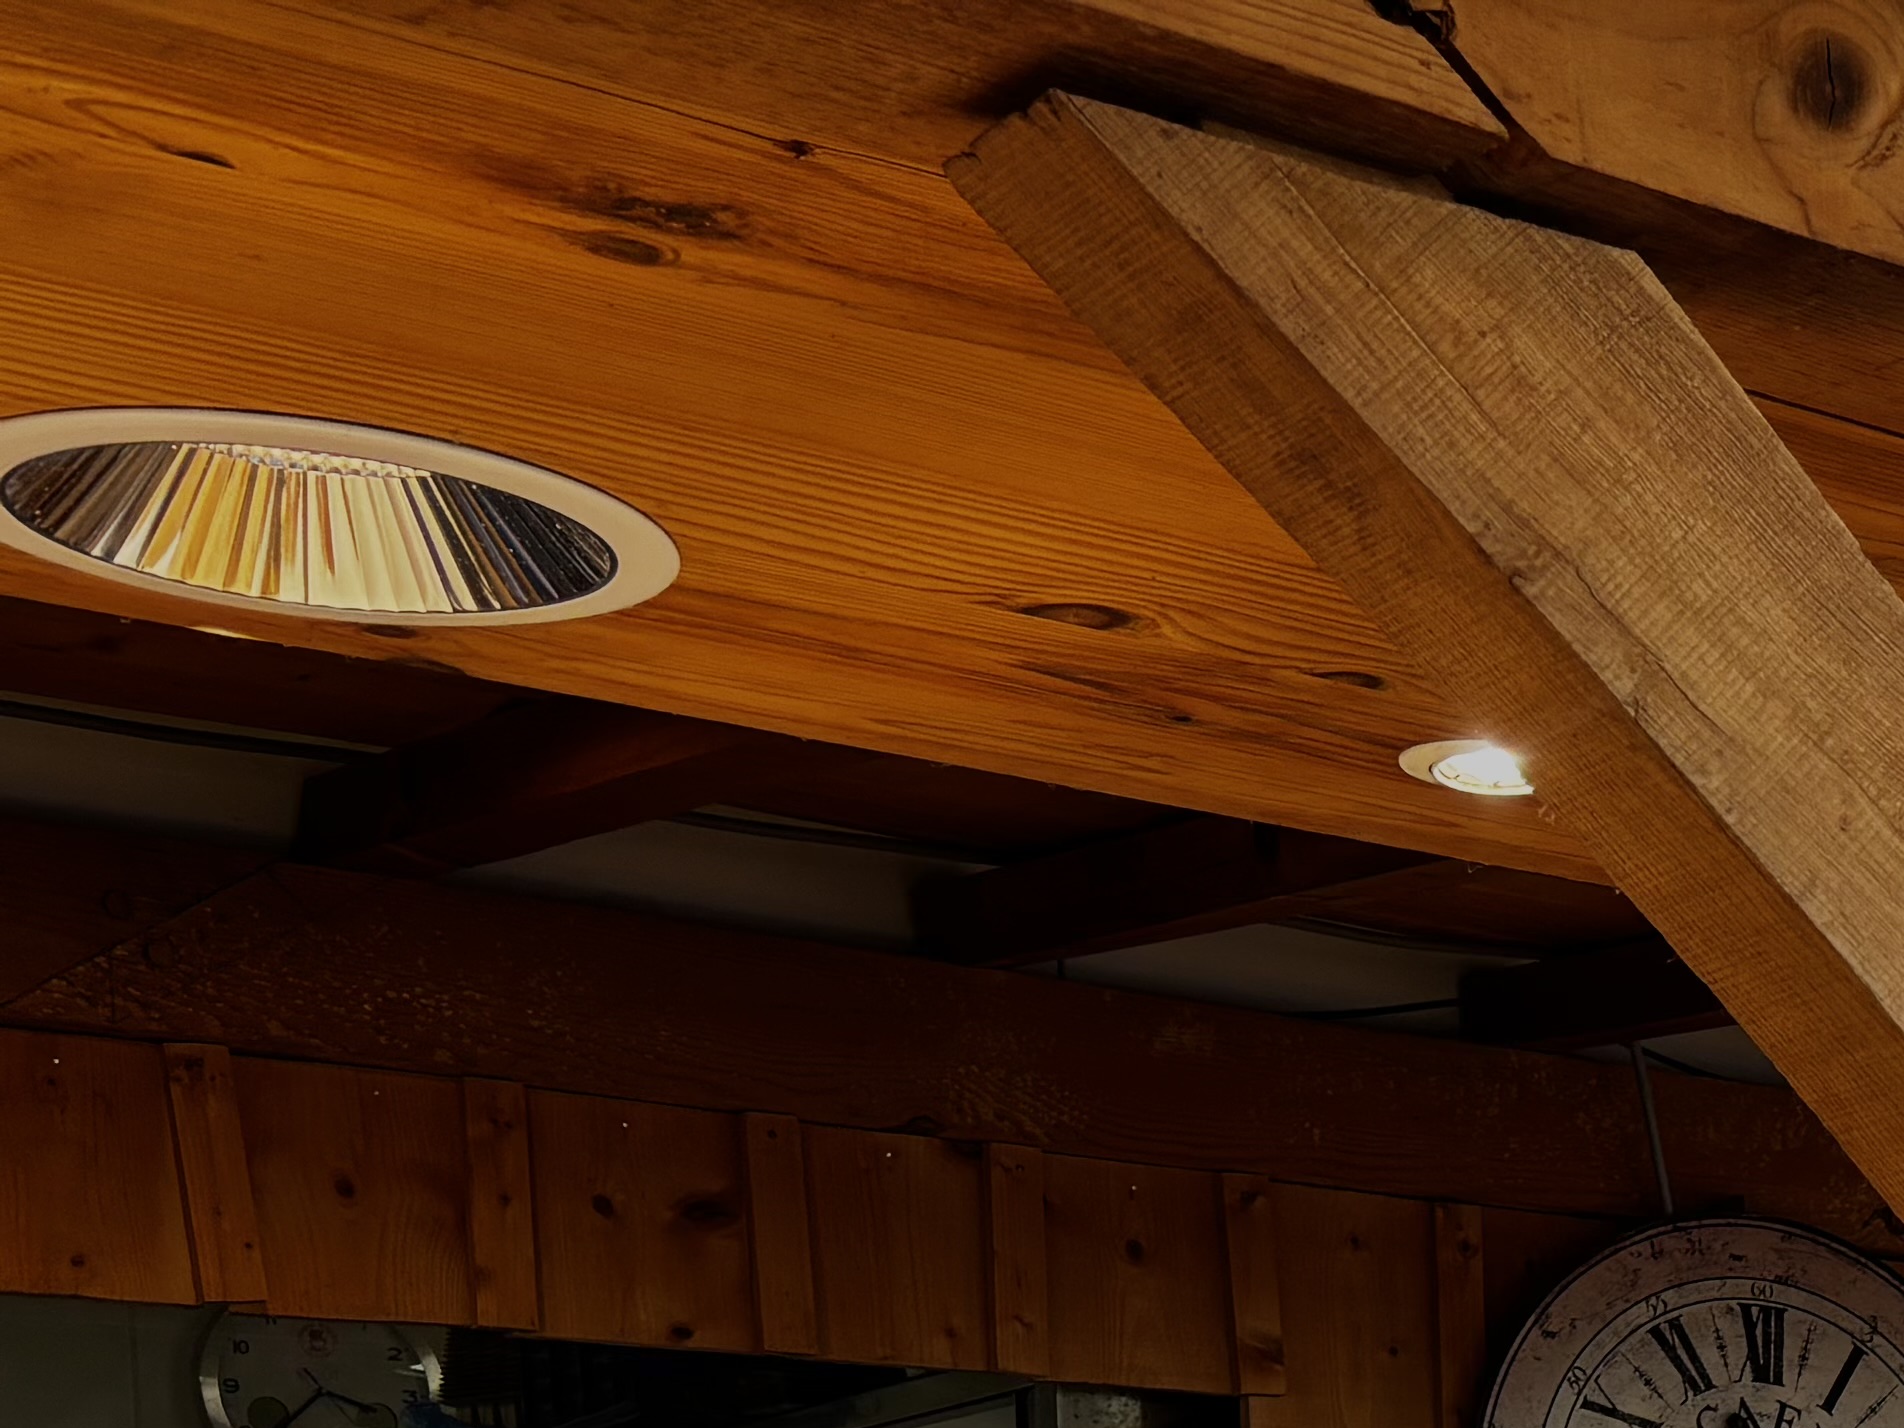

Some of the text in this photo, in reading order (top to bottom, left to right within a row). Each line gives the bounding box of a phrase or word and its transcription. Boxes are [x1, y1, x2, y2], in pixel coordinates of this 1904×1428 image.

[233, 1340, 249, 1354] 10
[388, 1347, 402, 1361] 2
[223, 1378, 240, 1394] 9
